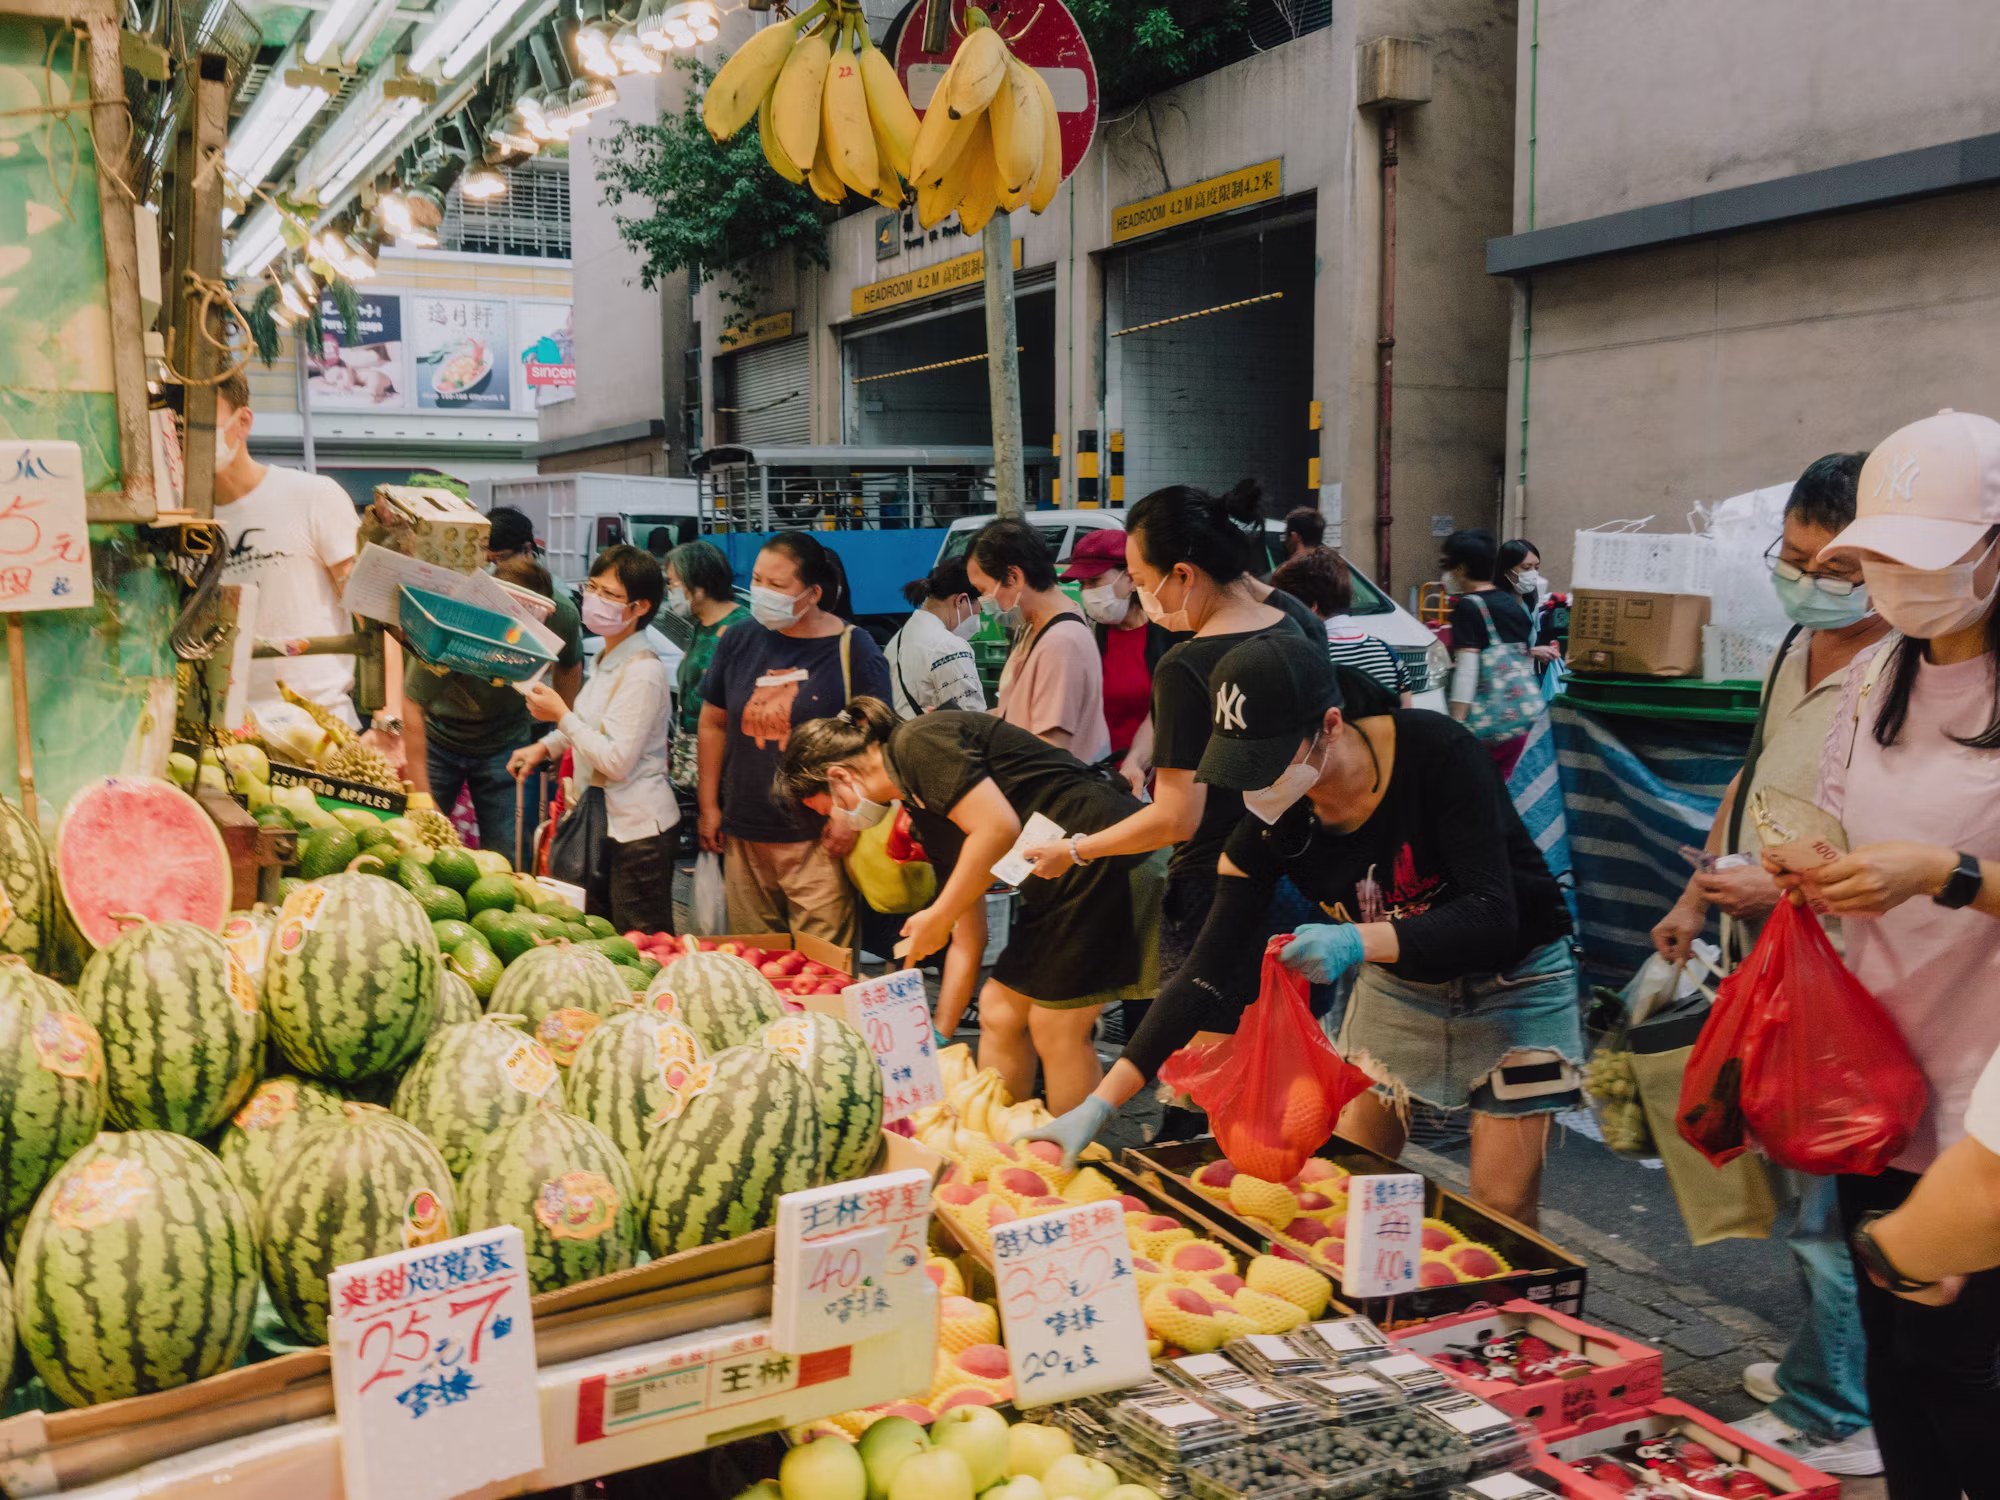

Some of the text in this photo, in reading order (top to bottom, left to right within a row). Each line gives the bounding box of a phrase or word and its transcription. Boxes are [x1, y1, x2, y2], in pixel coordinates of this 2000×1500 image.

[1116, 204, 1165, 232] HEADROOM
[1170, 200, 1183, 215] 4.2
[1185, 196, 1192, 211] M
[864, 256, 985, 304] HEADROOM 4.2 M 高度限制
[1215, 681, 1247, 730] NY
[338, 787, 392, 810] APPLES
[1812, 841, 1837, 860] 100
[808, 1248, 861, 1293] 40
[358, 1311, 430, 1396] 25
[449, 1285, 512, 1364] 7
[721, 1356, 792, 1394] 王林
